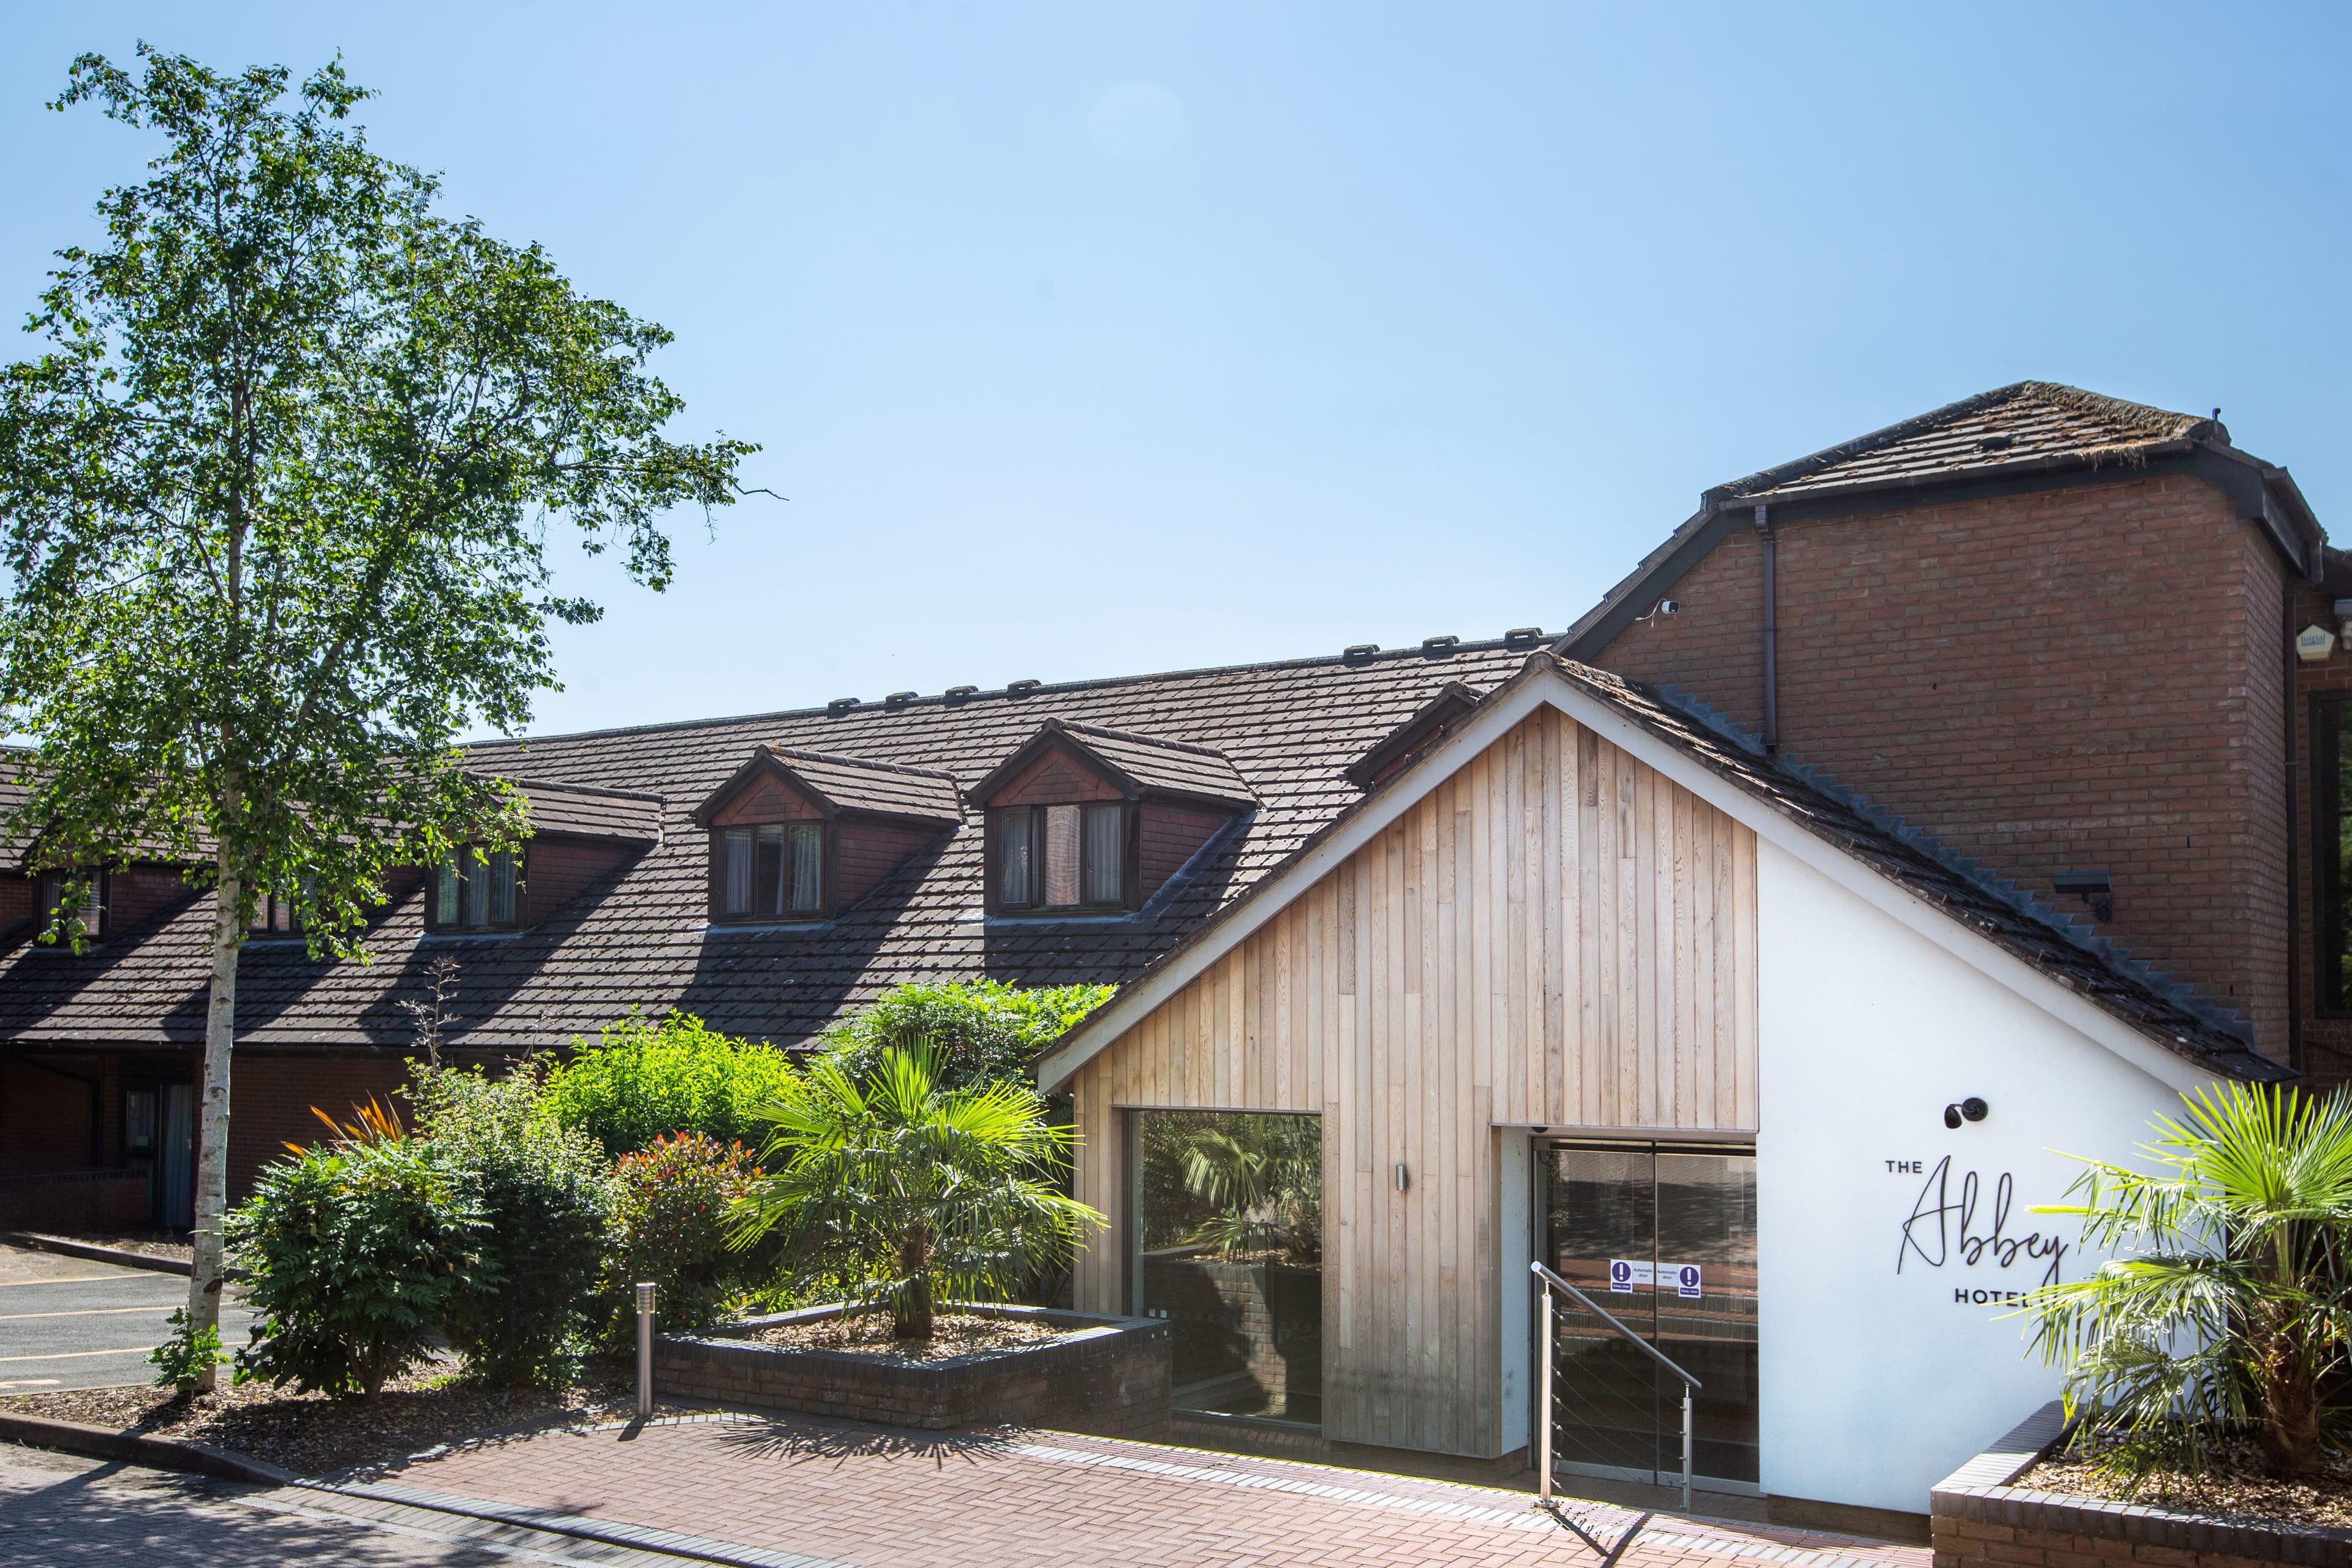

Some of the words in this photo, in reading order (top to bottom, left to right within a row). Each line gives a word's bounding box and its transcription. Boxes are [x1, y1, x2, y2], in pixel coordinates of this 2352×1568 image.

[1885, 1160, 1923, 1174] THE
[1898, 1155, 2069, 1309] Abbey
[1954, 1288, 2034, 1308] HOTEL
